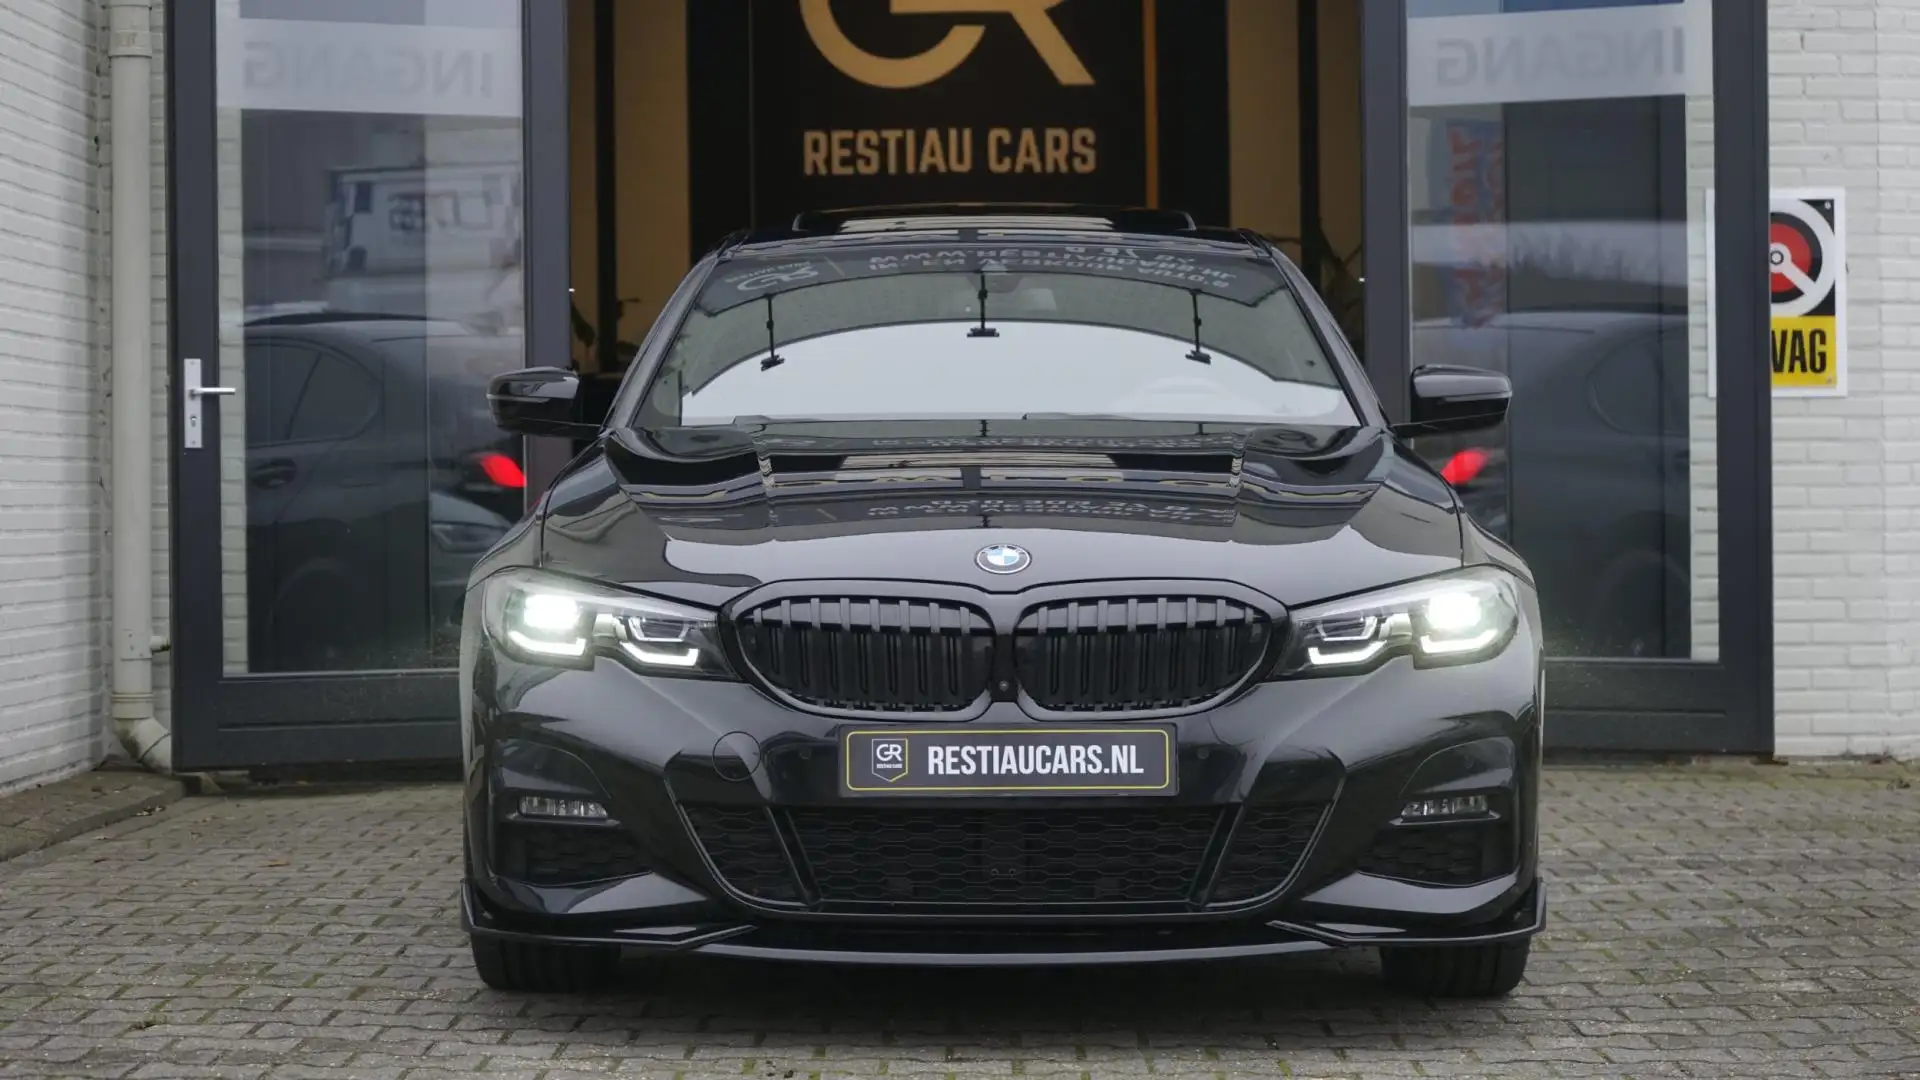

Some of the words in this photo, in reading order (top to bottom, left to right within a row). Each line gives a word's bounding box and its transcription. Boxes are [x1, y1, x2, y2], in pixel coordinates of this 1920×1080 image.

[803, 127, 973, 176] RESTIAU
[987, 127, 1097, 174] CARS
[1771, 328, 1828, 375] VAG
[927, 744, 1145, 775] RESTIAUCARS.NL
